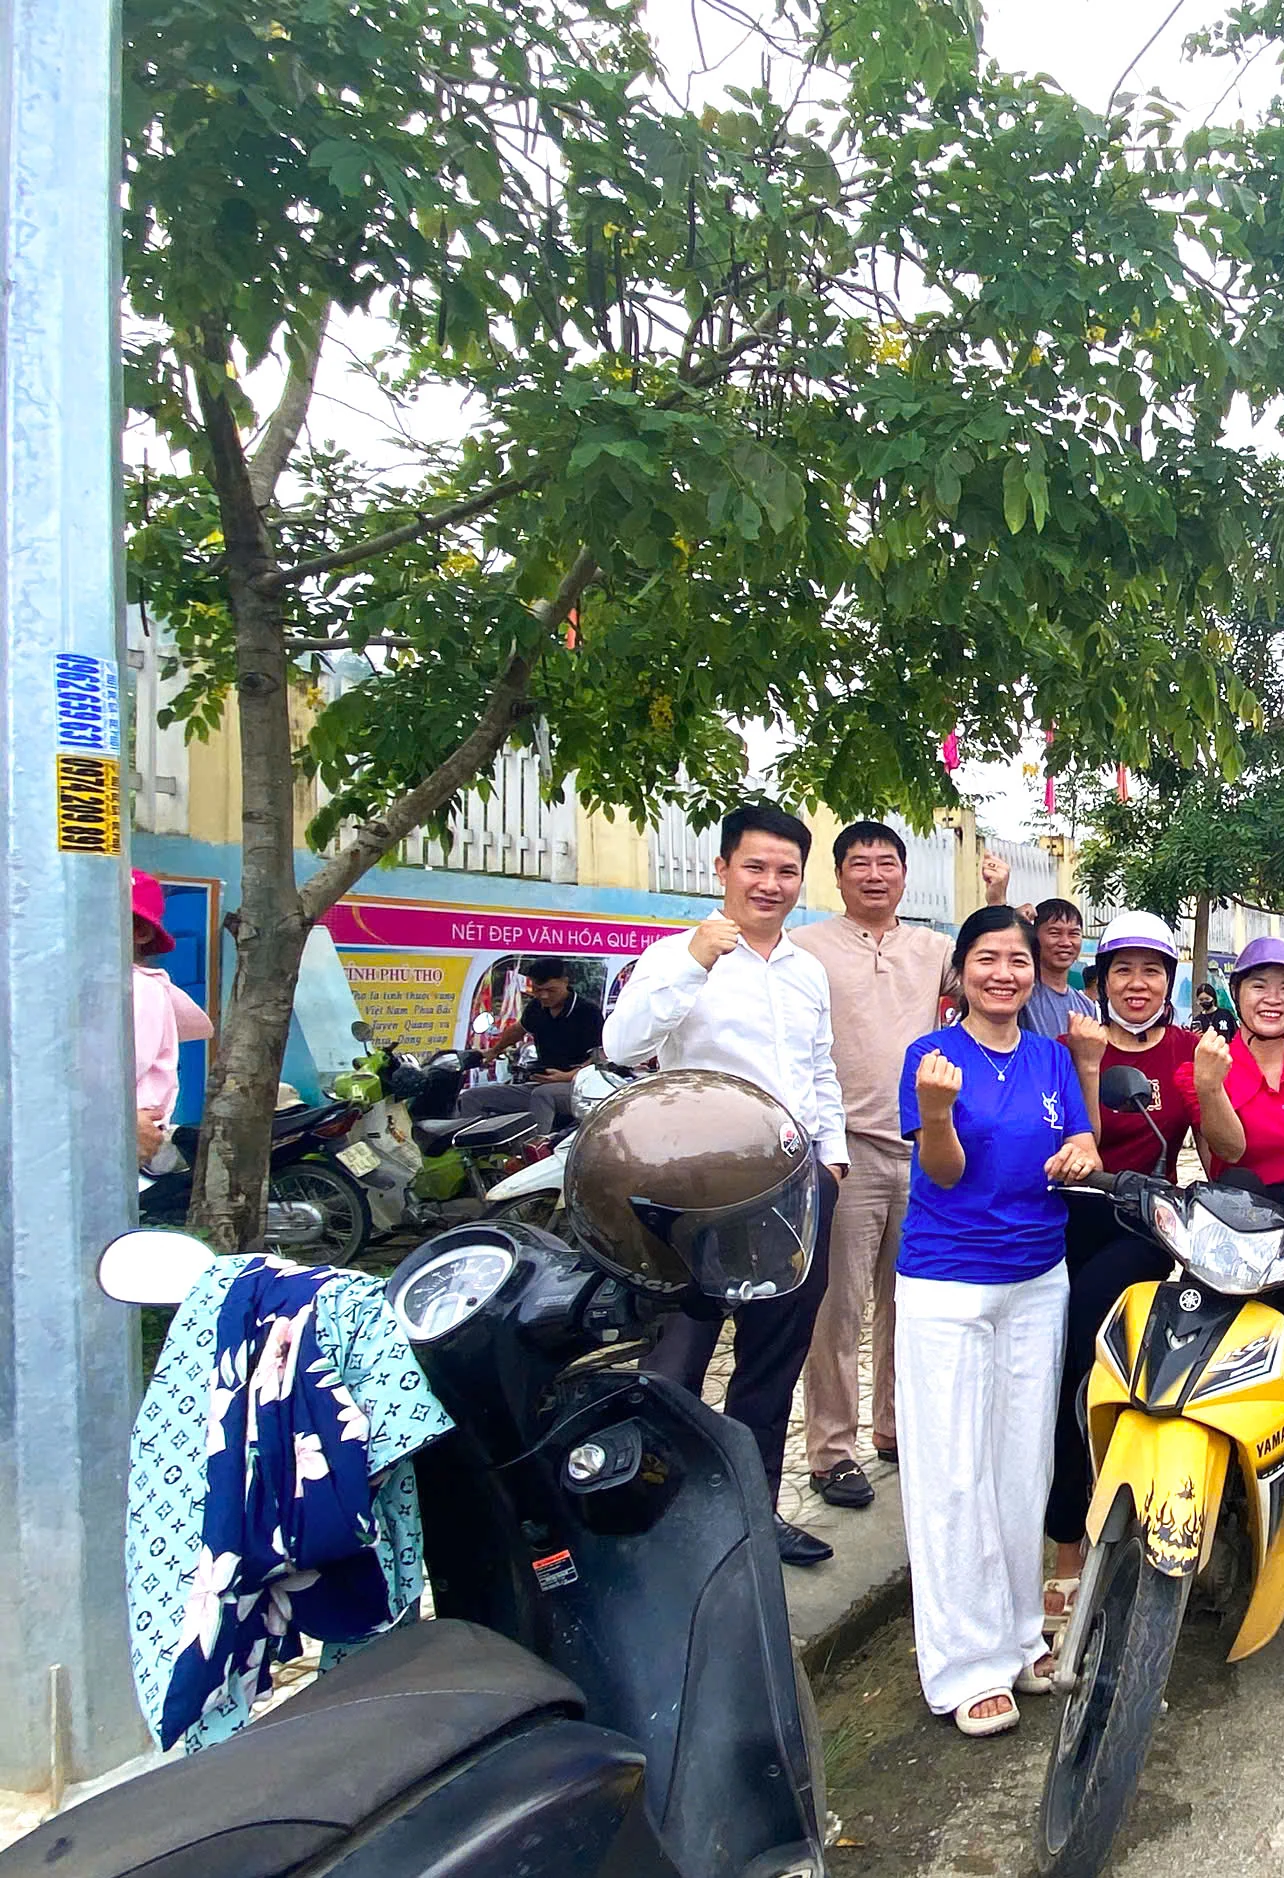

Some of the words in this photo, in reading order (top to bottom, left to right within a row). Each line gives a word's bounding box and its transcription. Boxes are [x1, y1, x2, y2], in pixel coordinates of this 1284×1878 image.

[56, 653, 104, 749] 0962.659.631
[60, 757, 106, 852] 0974.209.891
[451, 921, 483, 941] NÉT
[488, 925, 523, 945] ĐẸP
[528, 925, 563, 945] VĂN
[567, 928, 604, 947] HÓA
[607, 931, 637, 949] QUÊ
